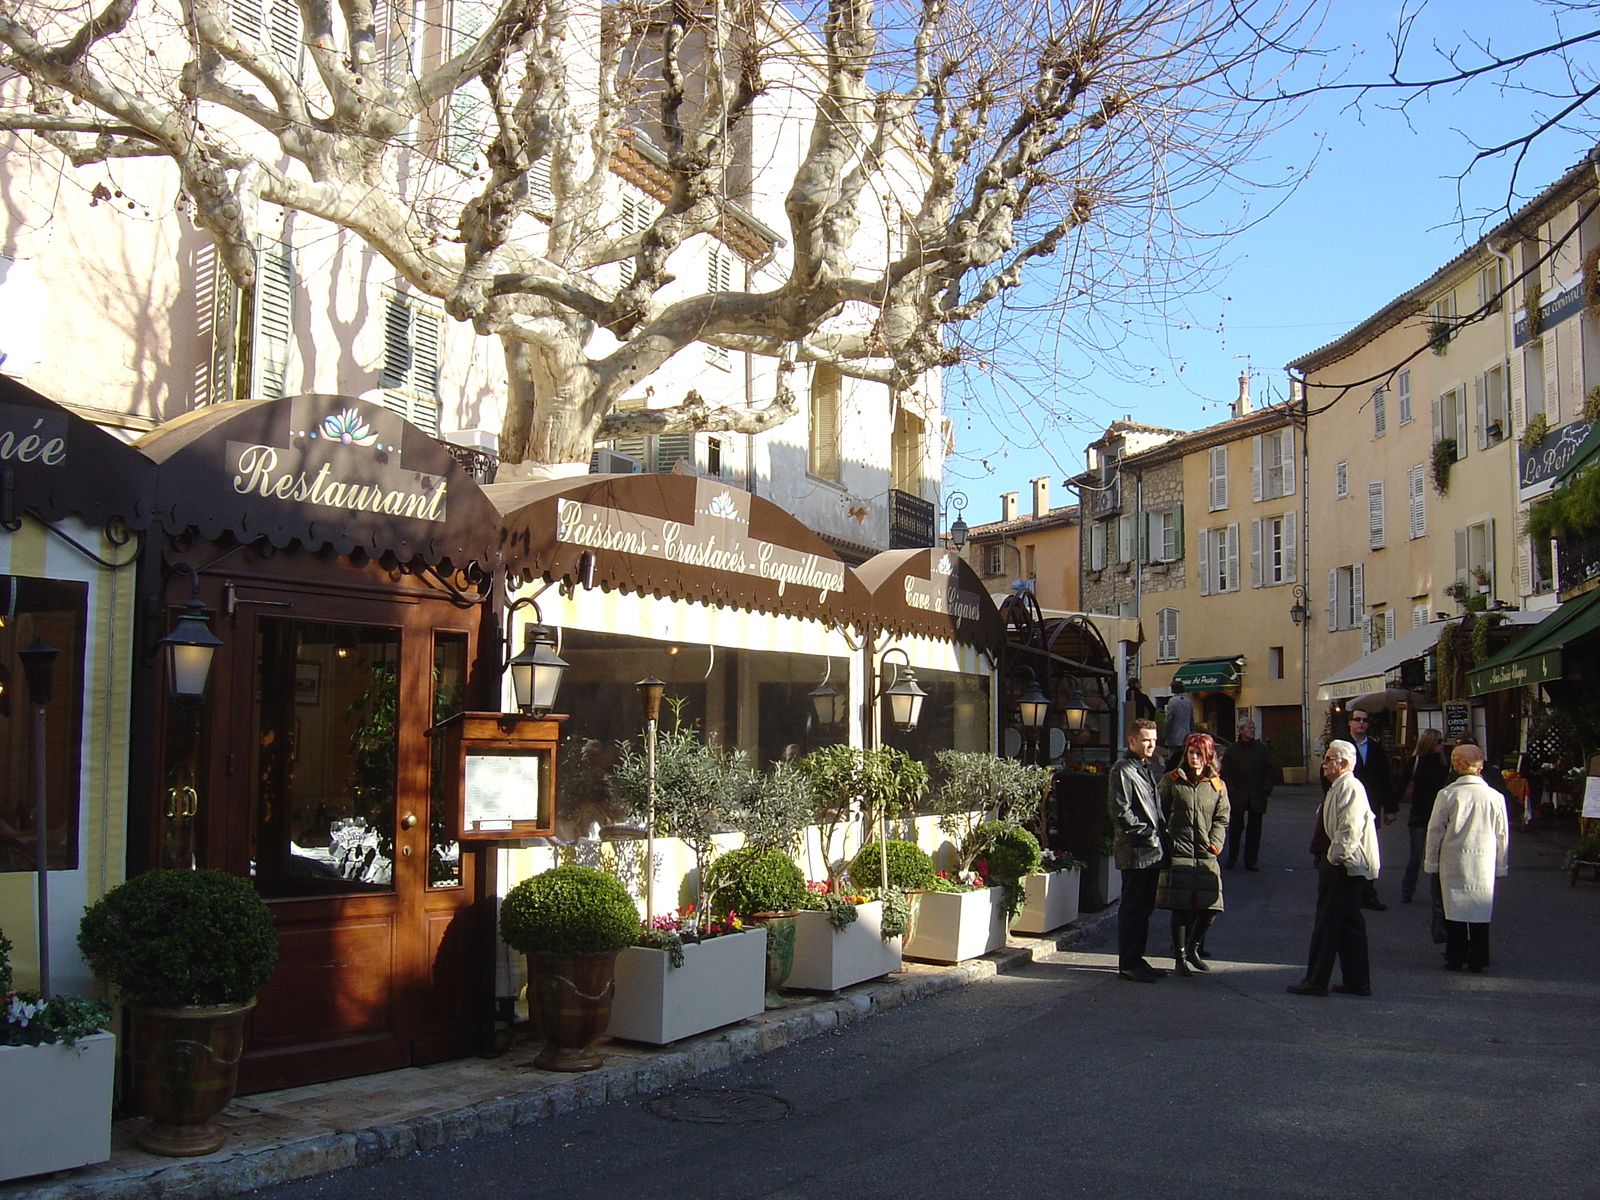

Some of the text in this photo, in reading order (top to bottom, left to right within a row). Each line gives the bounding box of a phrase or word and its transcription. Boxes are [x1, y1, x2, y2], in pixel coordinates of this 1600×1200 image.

[233, 445, 447, 521] Restaurant
[1521, 457, 1541, 484] Le
[558, 500, 647, 555] Poissons
[662, 520, 746, 574] Crustacés
[757, 541, 845, 604] Coquillages
[904, 574, 979, 629] Cave à Cigares
